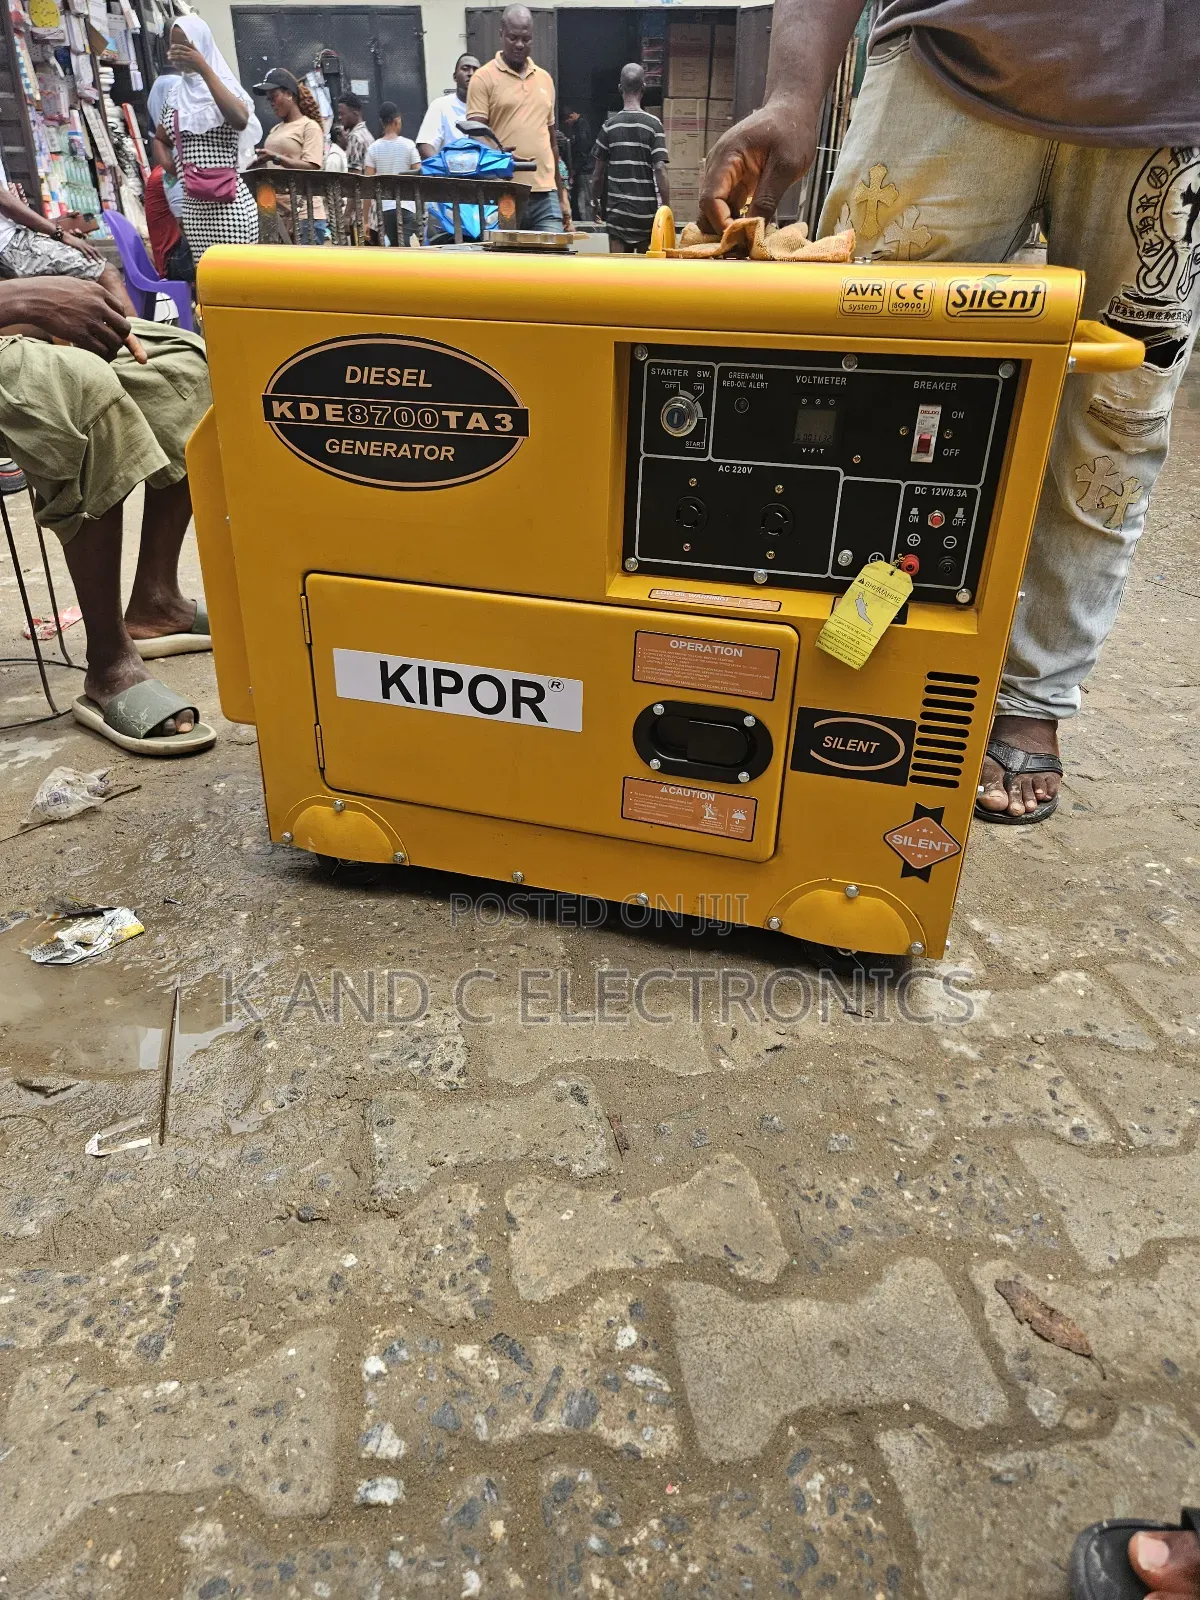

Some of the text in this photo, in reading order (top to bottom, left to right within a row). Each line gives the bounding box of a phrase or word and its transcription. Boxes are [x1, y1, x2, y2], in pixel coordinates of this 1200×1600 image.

[846, 283, 883, 297] AVR
[951, 282, 1042, 309] Silent
[848, 302, 878, 312] system
[891, 302, 926, 310] ISO9001
[345, 365, 433, 388] DIESEL
[650, 367, 712, 378] STARTER SW.
[728, 371, 764, 380] GREEN-RUN
[722, 380, 747, 388] RED-OIL
[796, 375, 847, 386] VOLTMETER
[913, 380, 957, 391] BREAKER
[271, 400, 514, 432] KDE8700TA3
[951, 410, 965, 419] ON
[685, 440, 705, 448] START
[325, 438, 455, 462] GENERATOR
[942, 448, 960, 457] OFF
[718, 465, 753, 475] AC 220V
[914, 486, 968, 498] DC 12V/8.3A
[908, 514, 920, 524] ON
[951, 518, 967, 527] OFF
[669, 639, 743, 658] OPERATION
[822, 735, 880, 754] SILENT
[668, 785, 715, 801] CAUTION
[891, 834, 953, 853] SILENT
